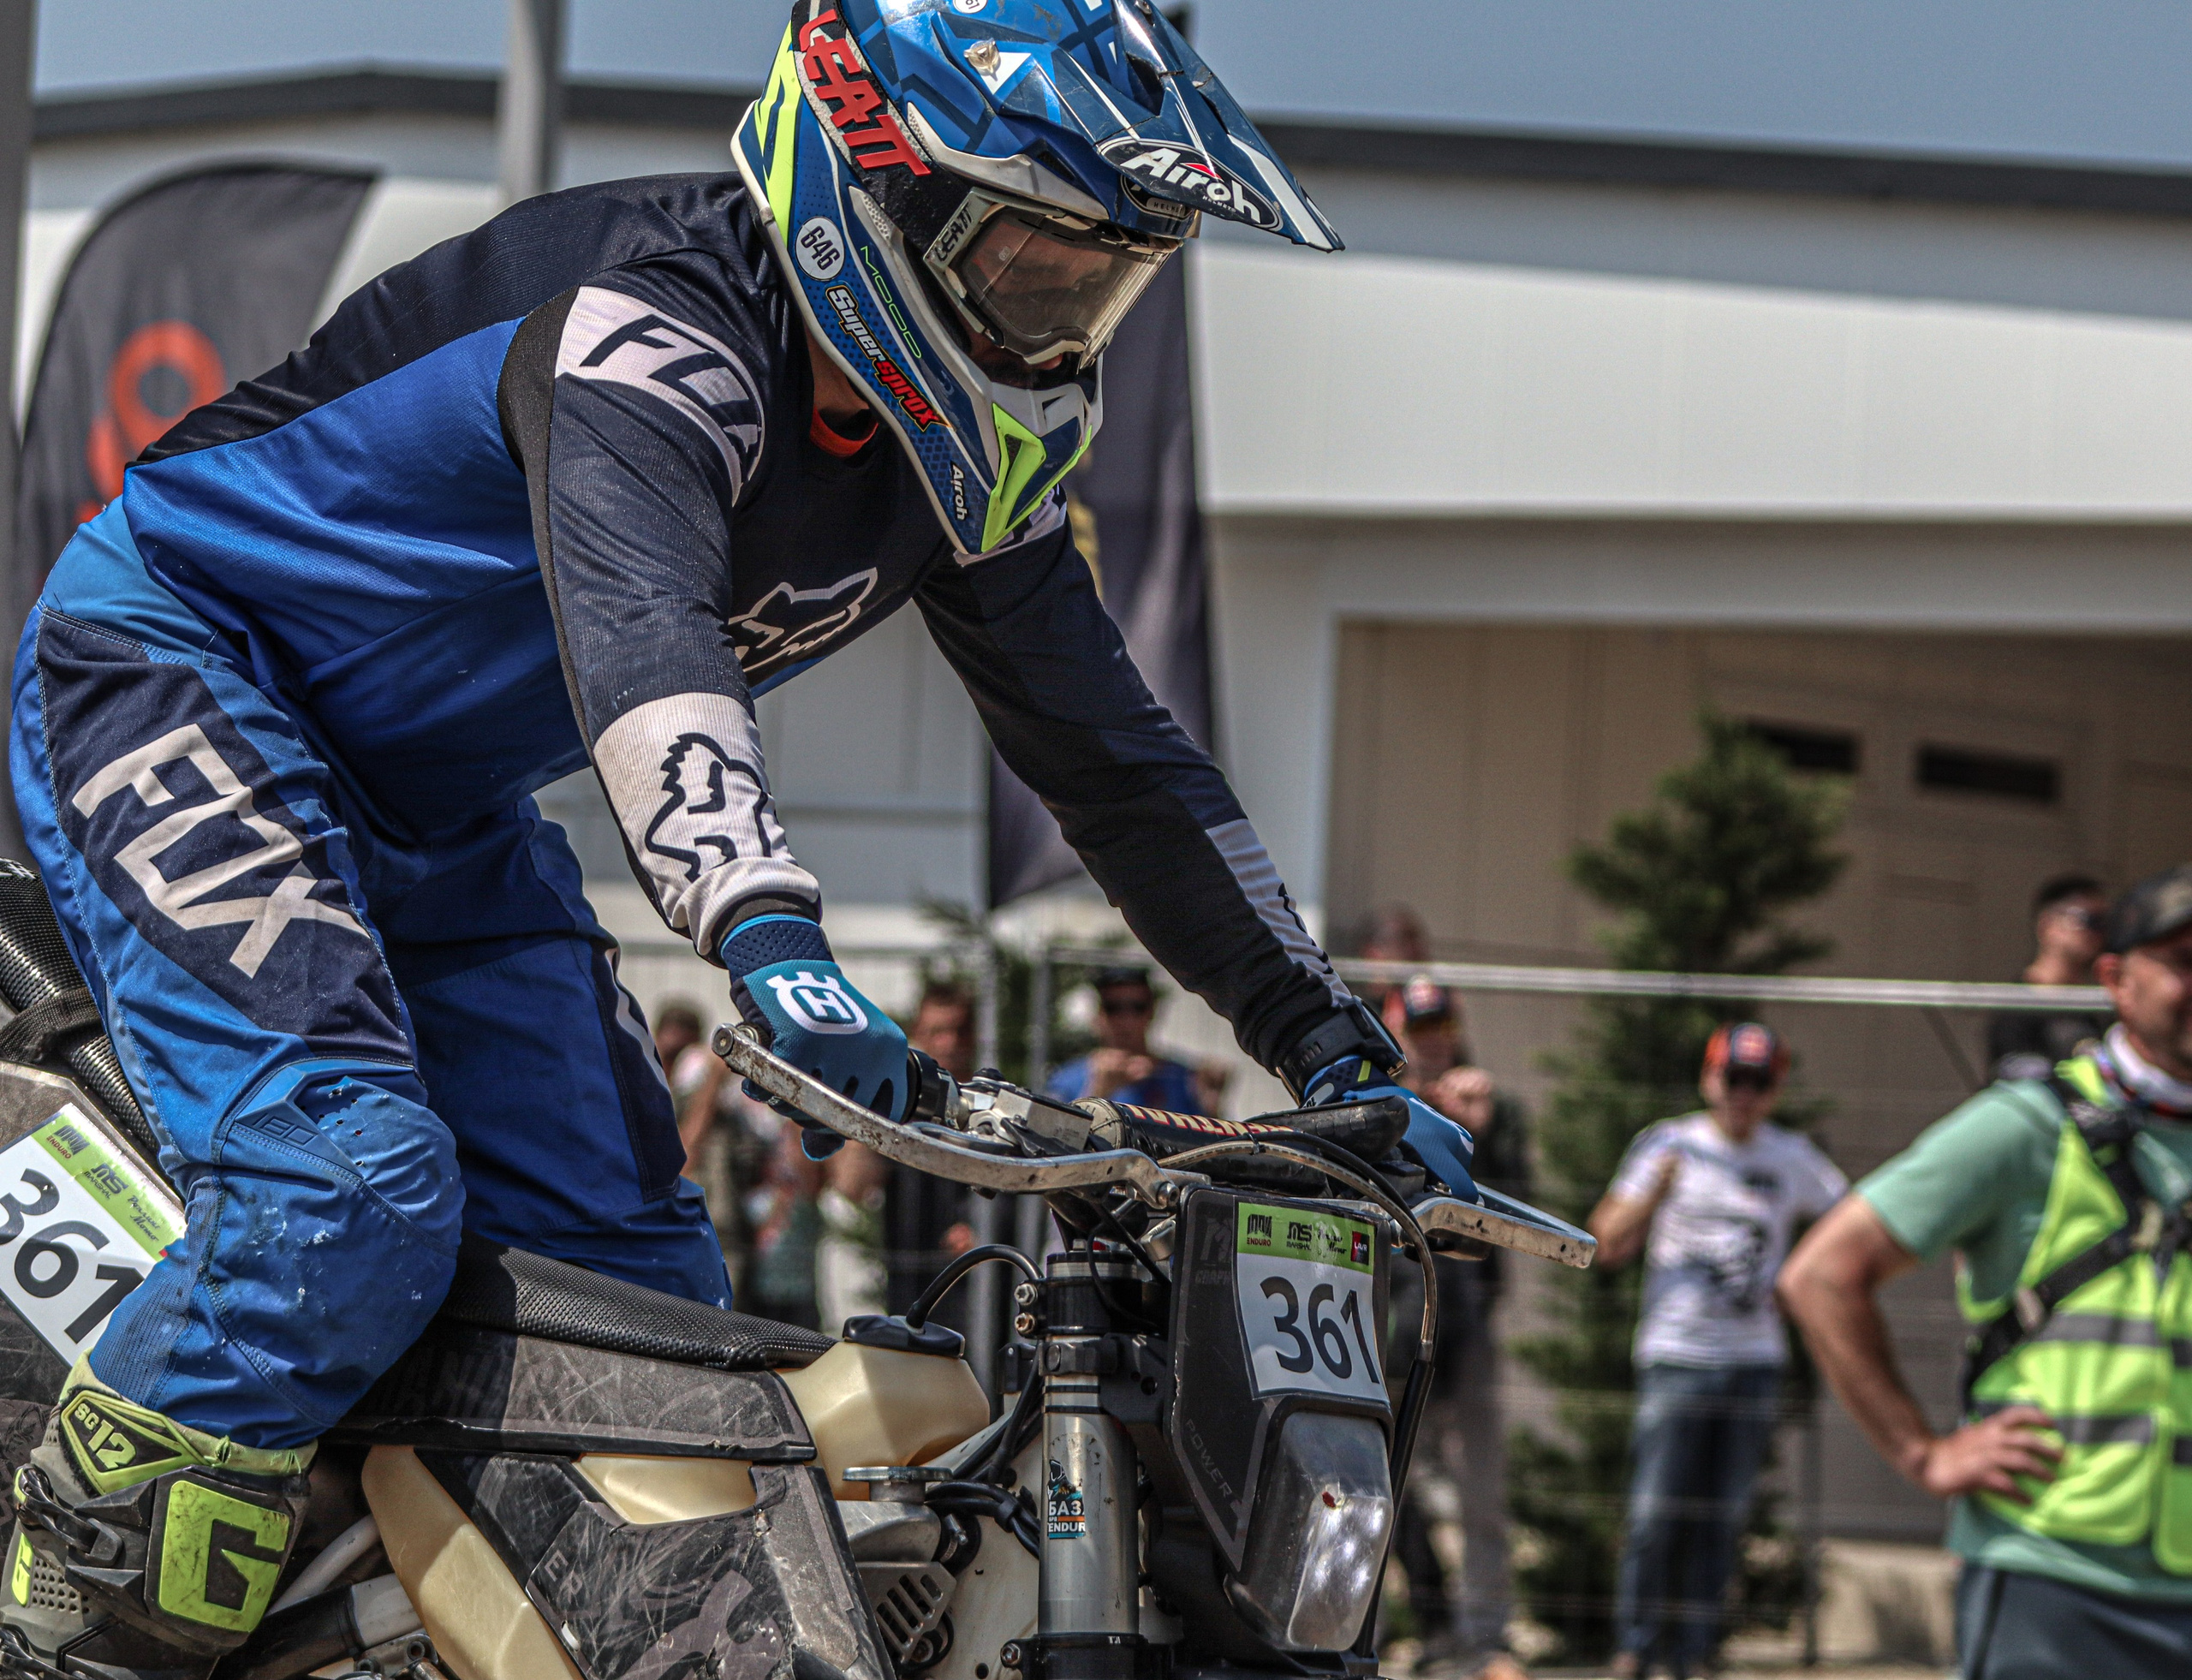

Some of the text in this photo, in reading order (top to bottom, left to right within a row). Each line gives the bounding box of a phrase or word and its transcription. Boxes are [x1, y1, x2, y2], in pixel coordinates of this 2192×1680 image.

[1120, 147, 1261, 223] Airoh
[801, 225, 841, 271] 646
[951, 464, 968, 521] Airoh
[72, 723, 375, 979] FOX
[46, 1135, 72, 1159] ENDURO
[84, 1171, 111, 1200] MARSHAL
[0, 1168, 145, 1344] 361
[1247, 1237, 1272, 1247] ENDURO
[1260, 1277, 1380, 1385] 361
[1185, 1418, 1234, 1498] POWER
[1049, 1499, 1085, 1516] БАЗ
